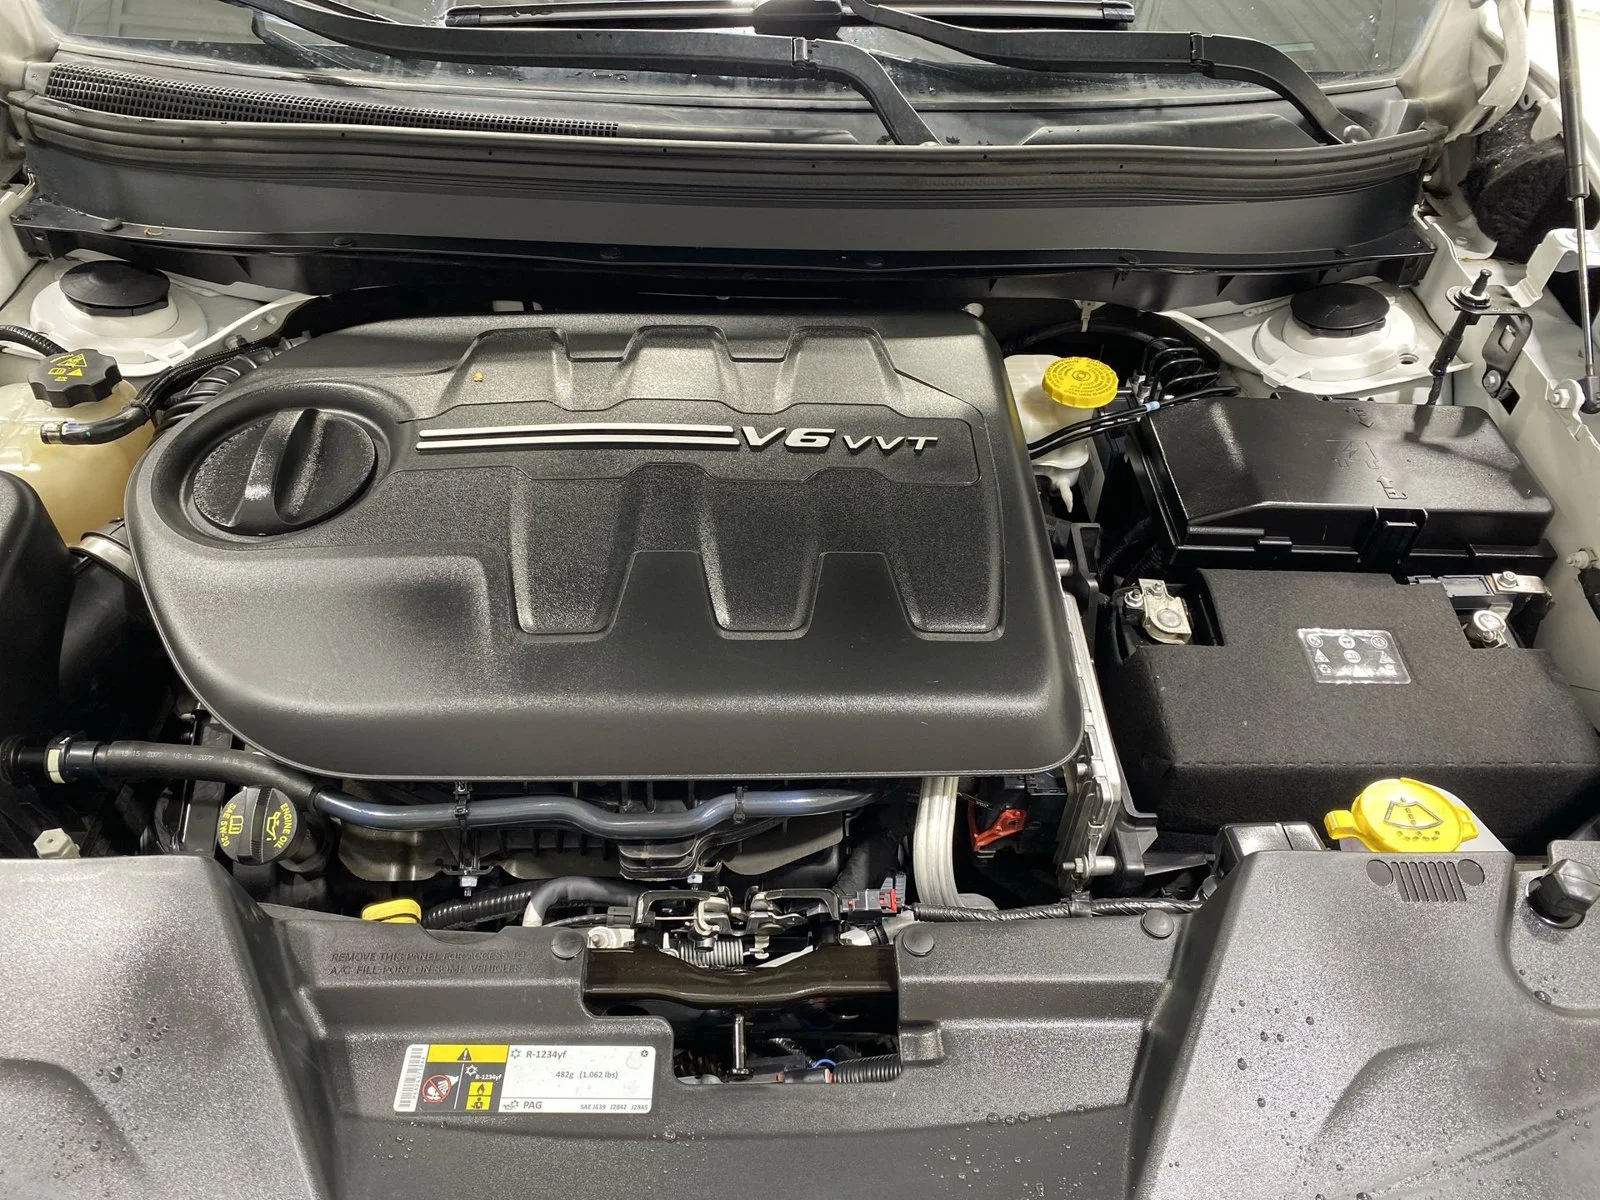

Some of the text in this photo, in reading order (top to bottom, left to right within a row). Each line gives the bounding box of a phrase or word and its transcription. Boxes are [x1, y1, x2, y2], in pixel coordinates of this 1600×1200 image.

[741, 426, 939, 452] V6 VVT
[220, 802, 237, 847] SAE 5W-20
[274, 802, 293, 849] ENGINE OIL
[331, 952, 376, 962] REMOVE
[379, 952, 404, 962] THIS
[405, 952, 439, 962] PANEL
[442, 951, 464, 961] FOR
[467, 951, 509, 960] ACCESS
[329, 965, 351, 975] A/C
[356, 965, 378, 975] FILL
[414, 965, 432, 974] ON
[434, 964, 465, 974] SOME
[470, 963, 523, 973] VEHICLES
[526, 1050, 567, 1060] R-1234yf
[475, 1073, 502, 1081] R-1234yf
[555, 1071, 619, 1079] 482g (1.062 lbs)
[523, 1101, 543, 1109] PAG
